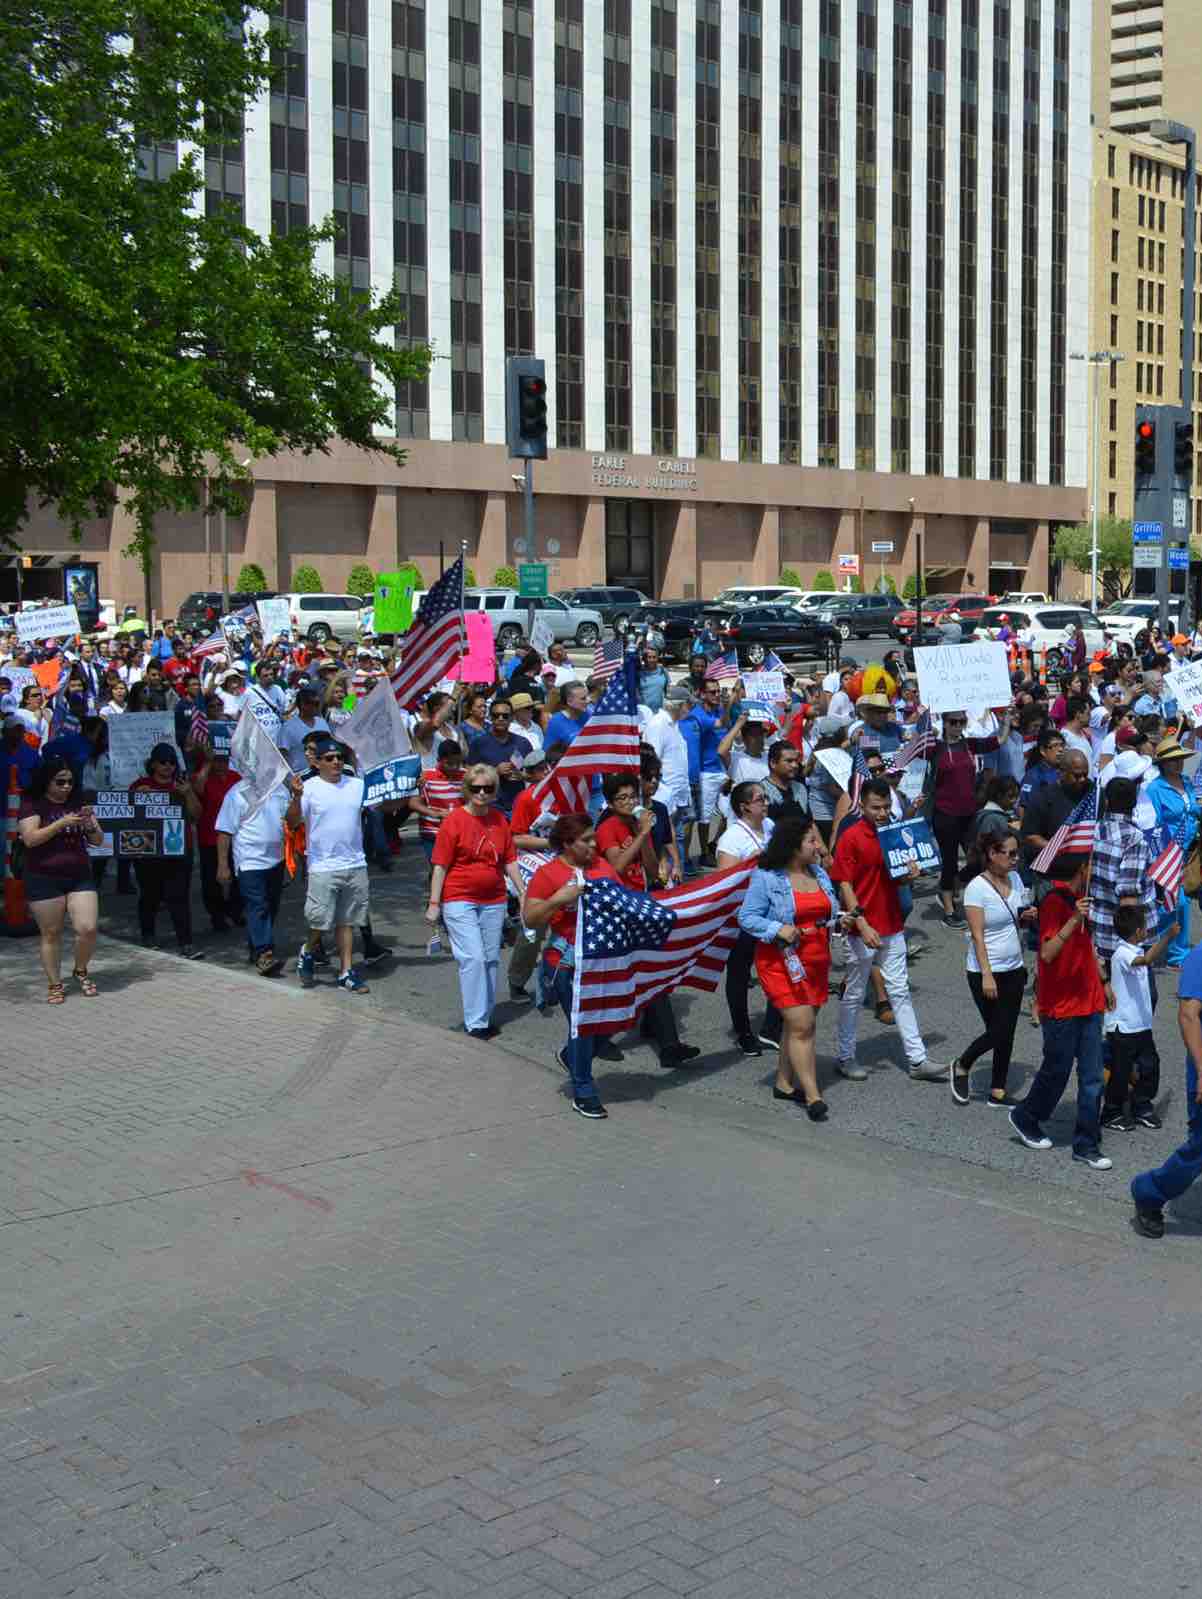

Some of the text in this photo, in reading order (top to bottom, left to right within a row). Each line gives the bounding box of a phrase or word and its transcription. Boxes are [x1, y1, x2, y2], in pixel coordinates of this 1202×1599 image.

[592, 455, 626, 471] EARLE
[592, 474, 698, 492] FEDERAL BUILDING
[98, 793, 169, 804] ONE RACE
[147, 806, 181, 817] RACE
